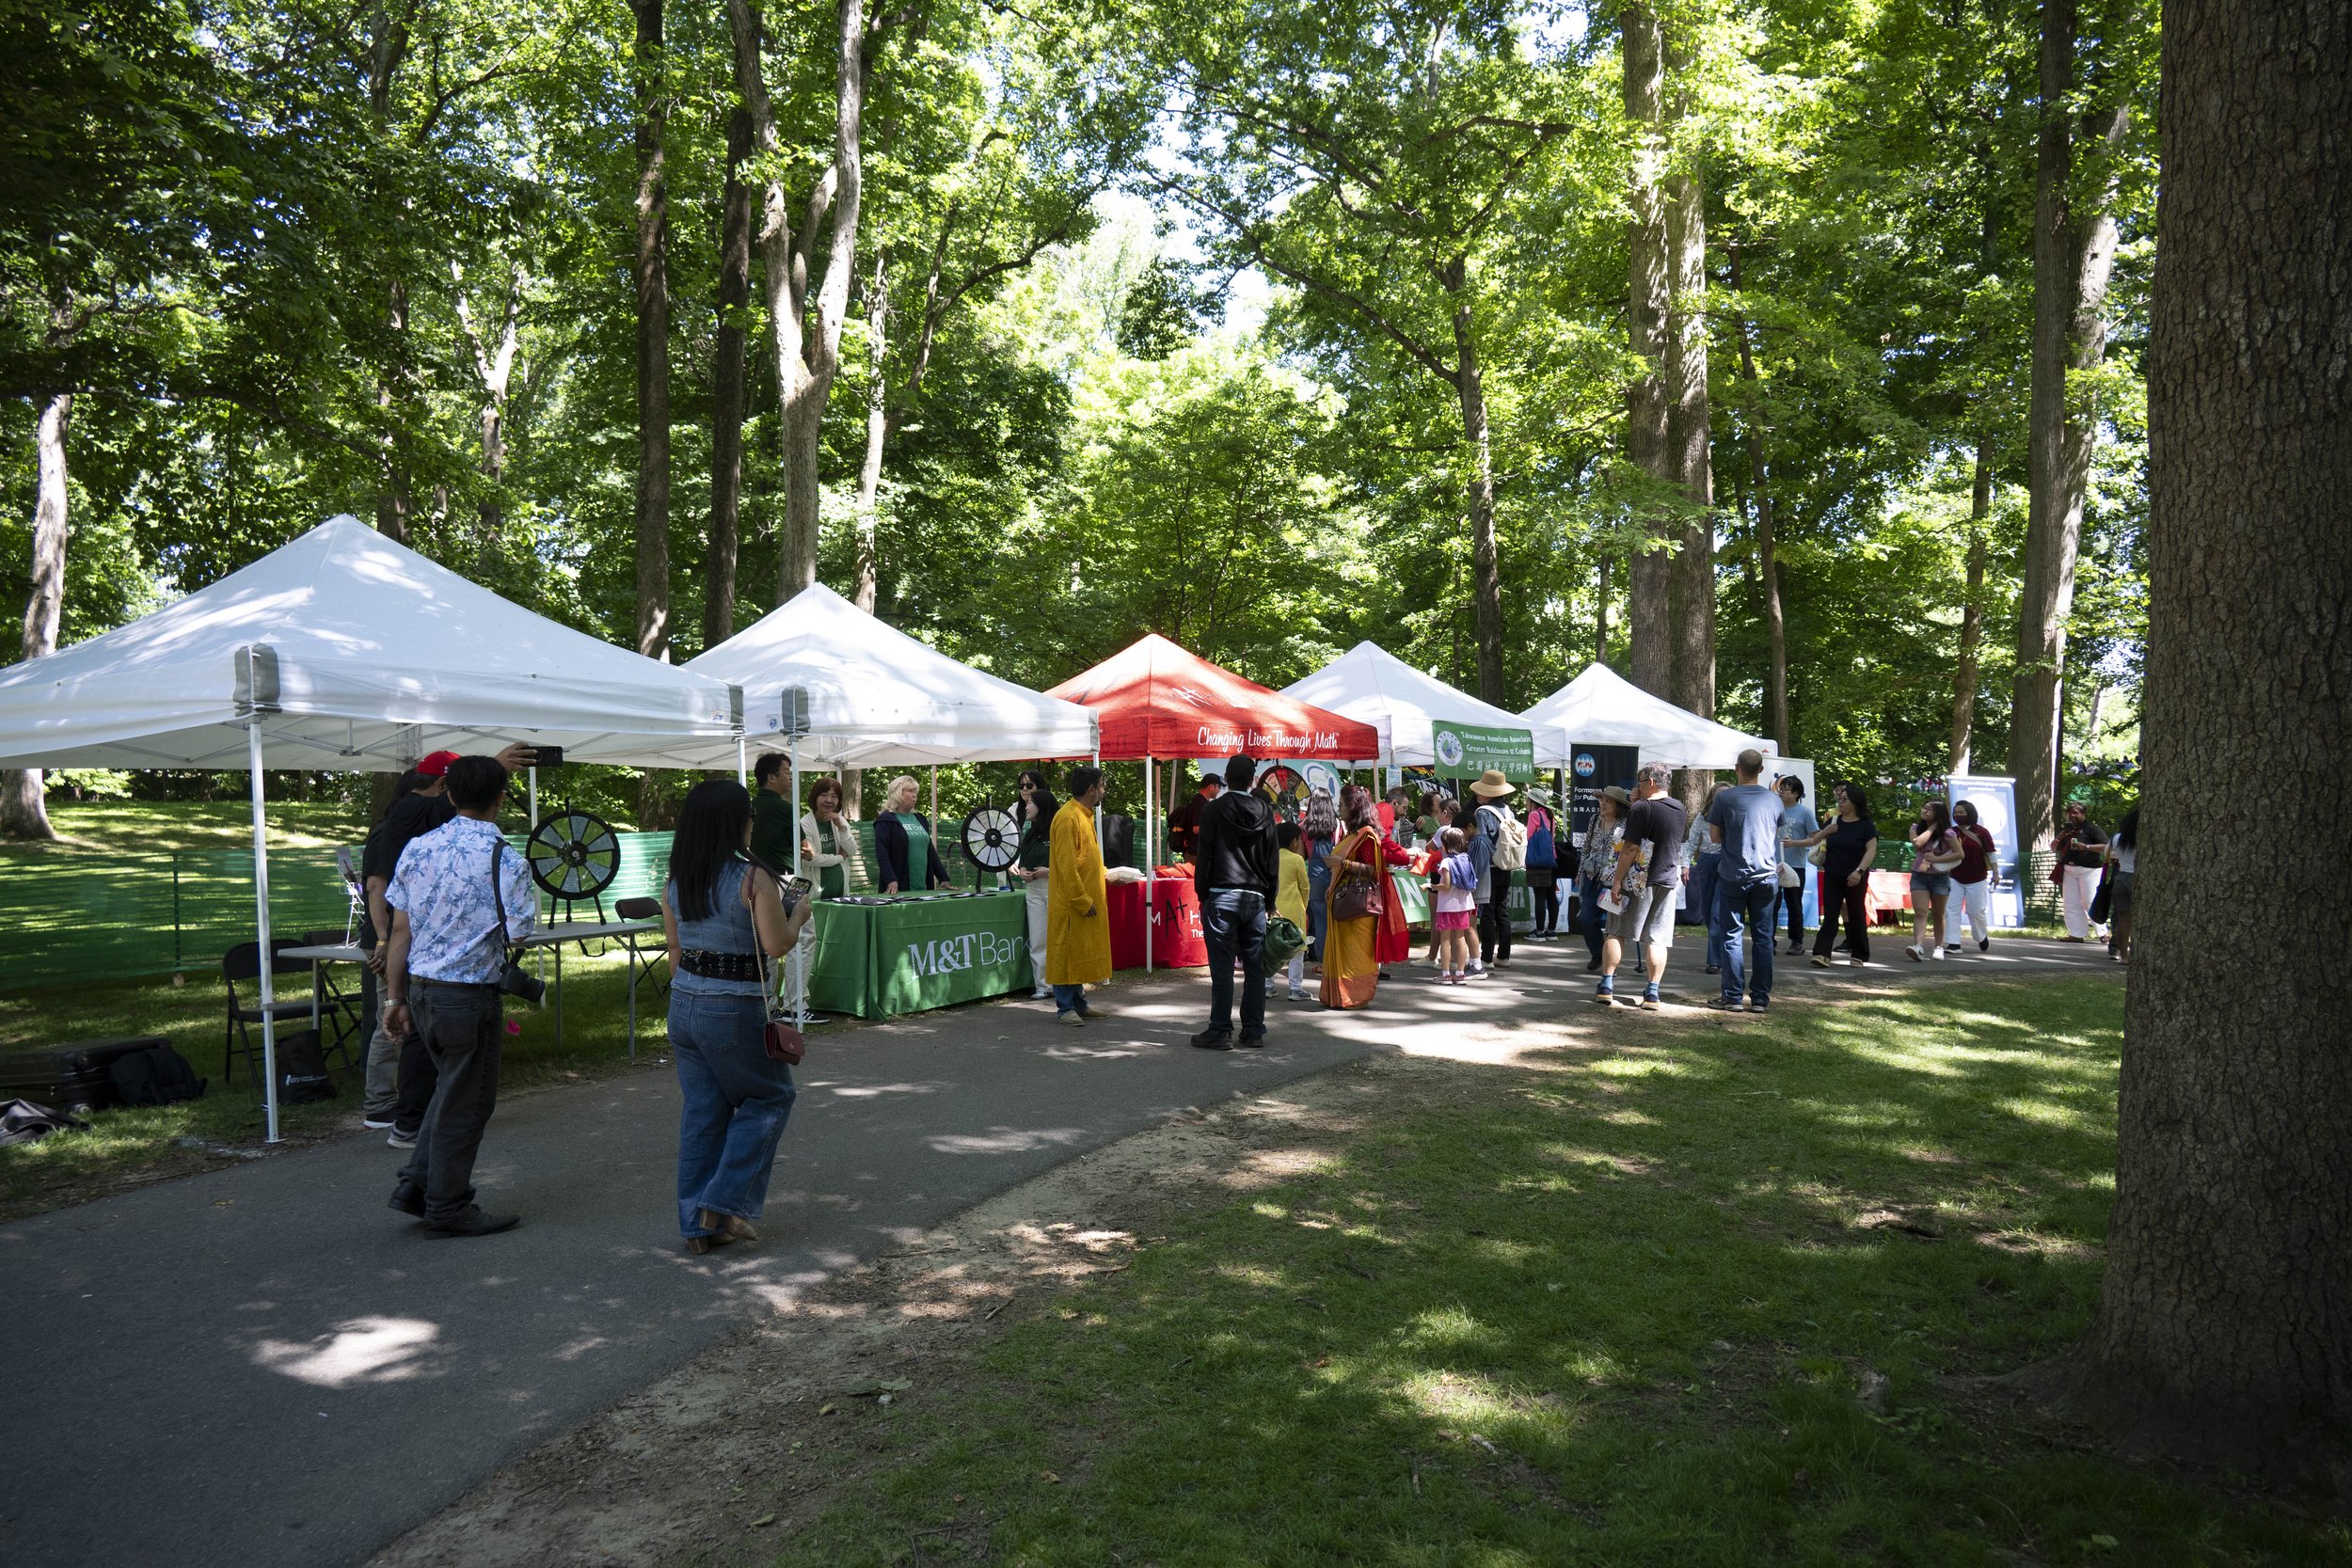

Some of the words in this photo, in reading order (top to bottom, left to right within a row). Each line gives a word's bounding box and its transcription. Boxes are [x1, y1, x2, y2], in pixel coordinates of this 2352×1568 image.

[1198, 726, 1244, 752] Changing
[1248, 729, 1272, 747] Lives
[1272, 730, 1311, 753] Through
[1460, 732, 1486, 741] Taiwanese
[1467, 744, 1486, 752] Greater
[1486, 746, 1509, 754] Baltimore
[1191, 929, 1204, 938] The
[908, 934, 976, 978] M&T
